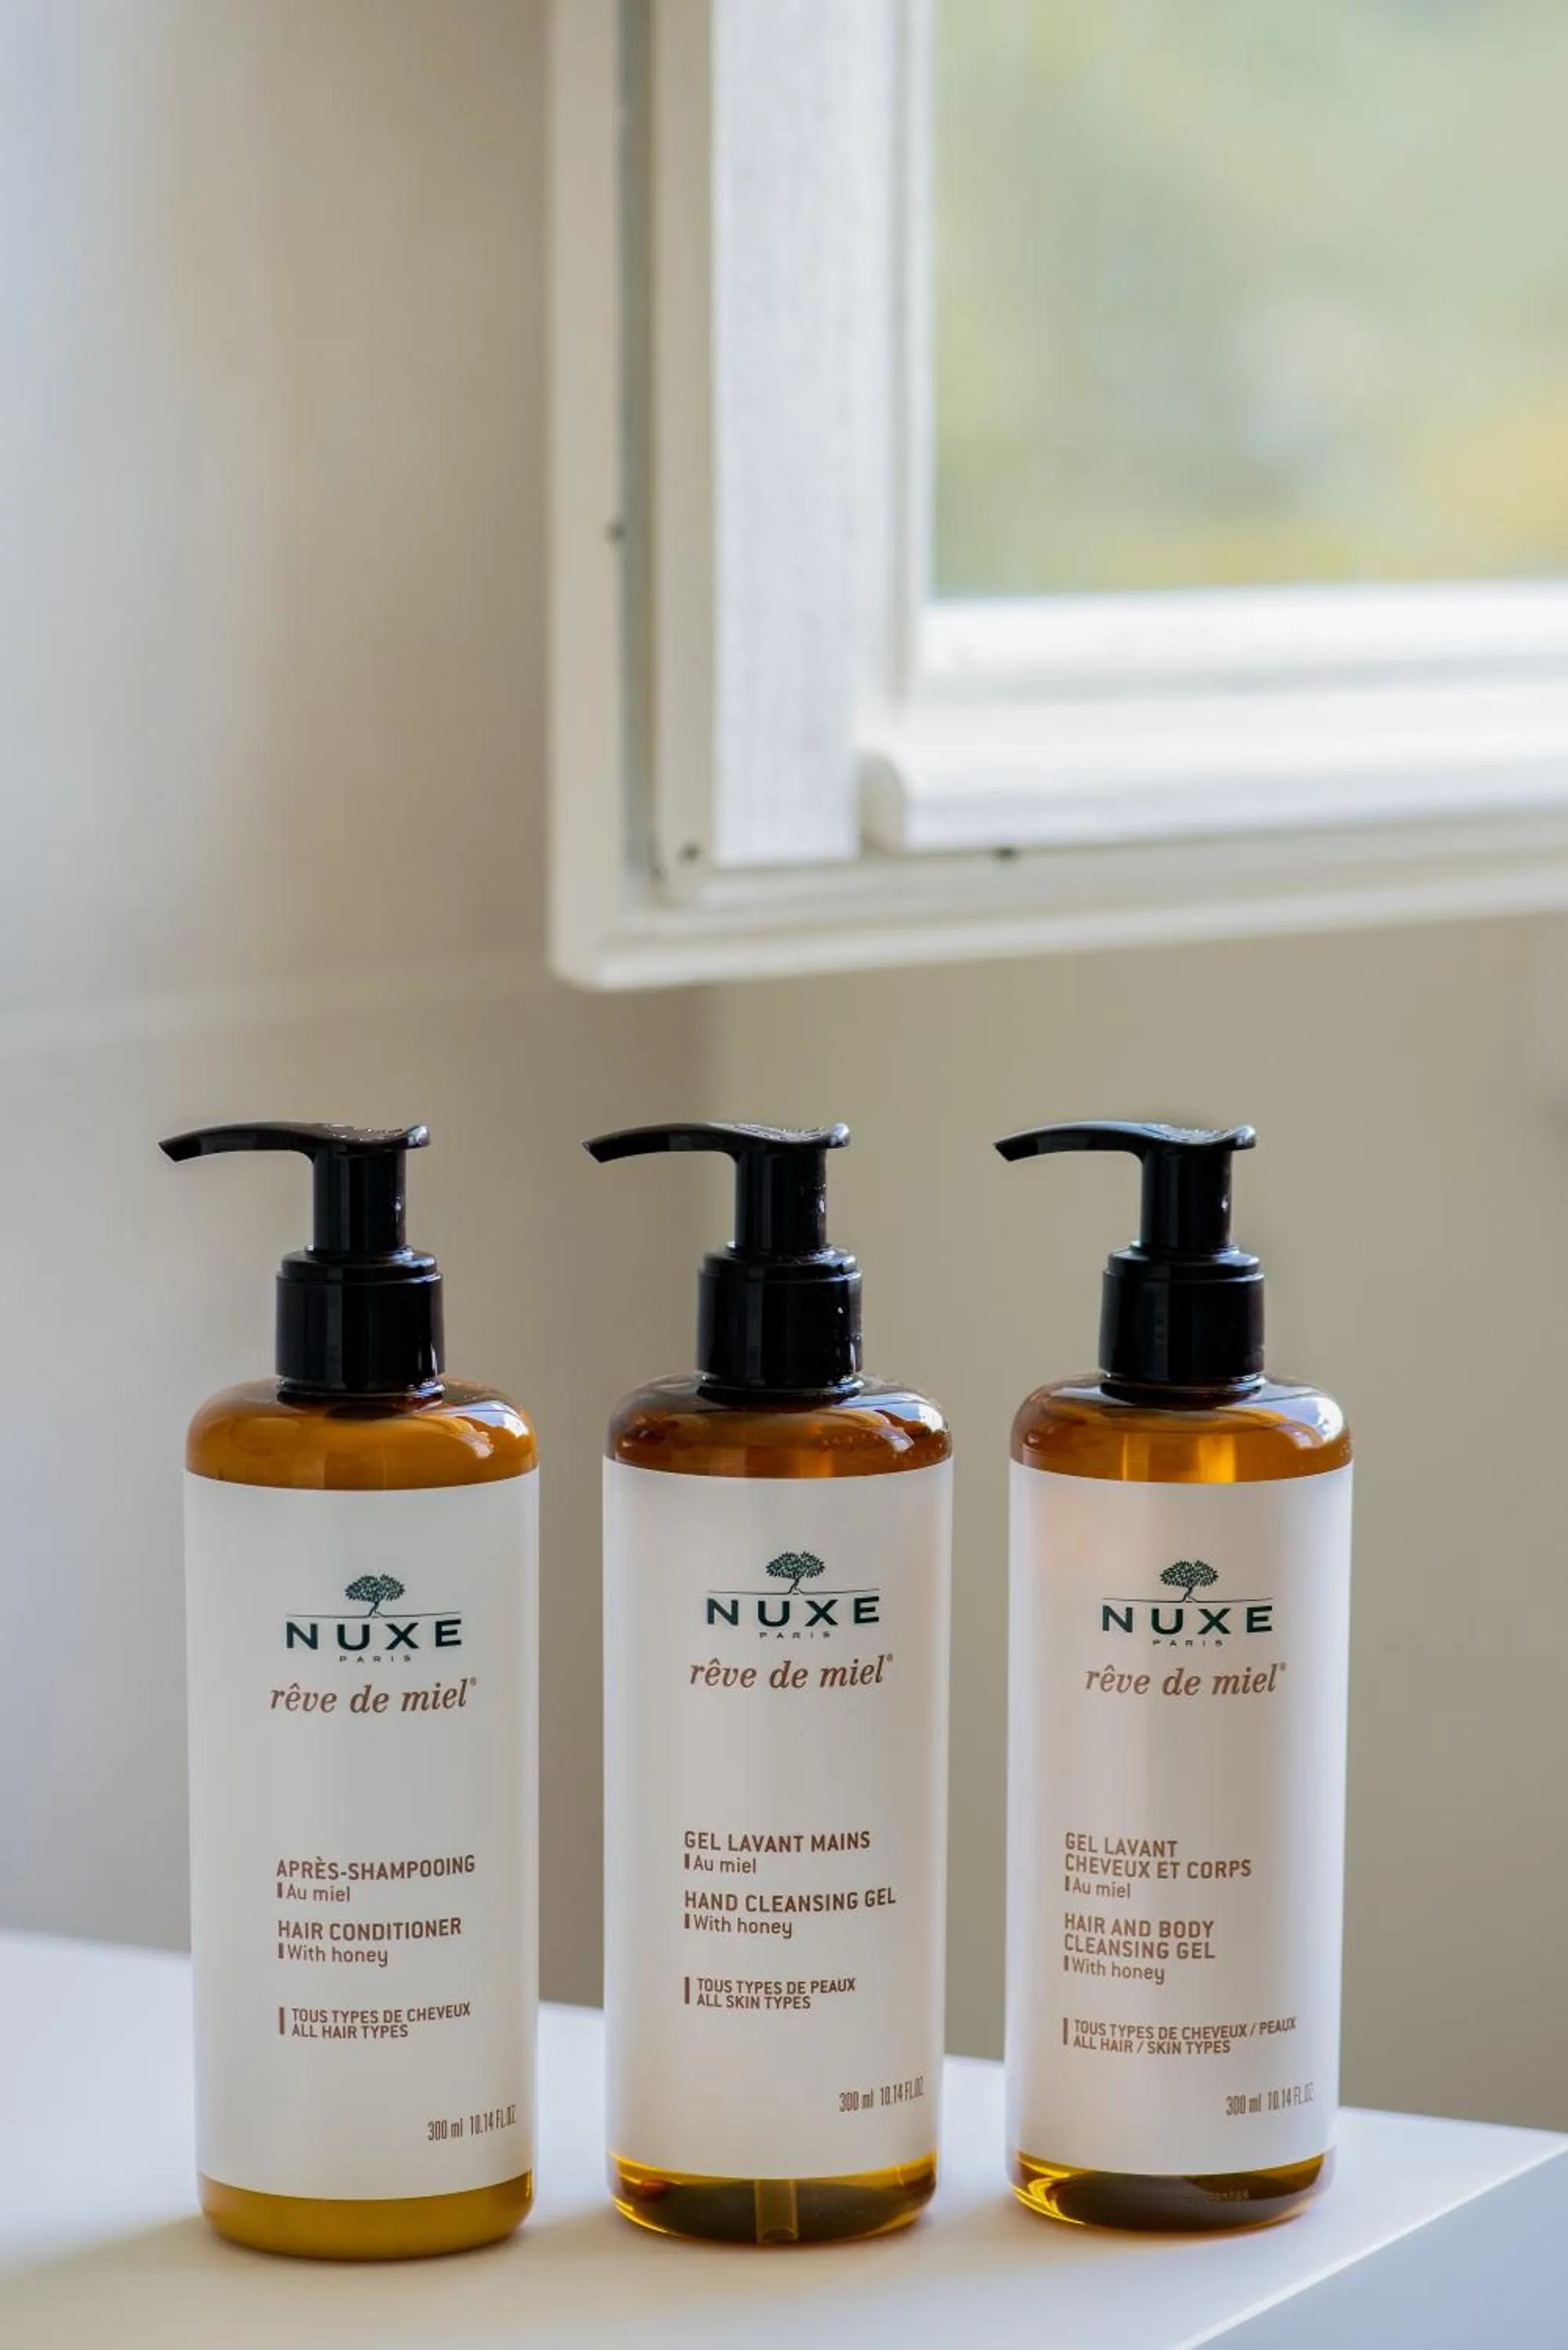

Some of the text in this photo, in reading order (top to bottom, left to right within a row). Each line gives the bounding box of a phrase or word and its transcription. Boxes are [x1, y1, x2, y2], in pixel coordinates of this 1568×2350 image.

[707, 1596, 880, 1627] NUXE
[1102, 1605, 1273, 1635] NUXE
[287, 1619, 462, 1650] NUXE
[690, 1658, 757, 1688] rêve
[770, 1661, 808, 1688] de
[1086, 1665, 1151, 1694] rêve
[1162, 1668, 1200, 1696] de
[270, 1683, 338, 1712] rêve
[350, 1686, 389, 1713] de
[685, 1831, 870, 1853] GEL LAVANT MAINS
[1065, 1832, 1177, 1857] GEL LAVANT
[276, 1855, 475, 1880] APRÈS-SHAMPOOING
[694, 1855, 757, 1874] Au miel
[1065, 1854, 1252, 1879] CHEVEUX ET CORPS
[287, 1883, 350, 1902] Au miel
[685, 1887, 896, 1912] HAND CLEANSING GEL
[1073, 1878, 1130, 1898] Au miel
[278, 1918, 461, 1940] HAIR CONDITIONER
[694, 1914, 793, 1939] With honey
[1064, 1913, 1215, 1938] HAIR AND BODY
[287, 1944, 388, 1968] With honey
[1064, 1933, 1215, 1958] CLEANSING GEL
[1073, 1958, 1165, 1985] With honey
[697, 1978, 855, 1994] TOUS TYPES DE PEAUX
[291, 2001, 471, 2024] TOUS TYPES DE CHEVEUX
[697, 1994, 811, 2009] ALL SKIN TYPES
[291, 2024, 408, 2038] ALL HAIR TYPES
[1075, 2019, 1106, 2035] TOUS
[1110, 2024, 1154, 2039] TYPES
[1158, 2026, 1176, 2040] DE
[1182, 2023, 1247, 2040] CHEVEUX
[1259, 2017, 1296, 2035] PEAUX
[1074, 2036, 1096, 2049] ALL
[1100, 2041, 1133, 2053] HAIR
[1147, 2041, 1181, 2054] SKIN
[1185, 2041, 1230, 2054] TYPES
[840, 2091, 858, 2112] 300
[862, 2088, 873, 2109] ml
[1226, 2095, 1245, 2115] 300
[1249, 2093, 1261, 2113] ml
[428, 2120, 447, 2140] 300
[451, 2118, 463, 2137] ml
[470, 2112, 493, 2135] 10.14
